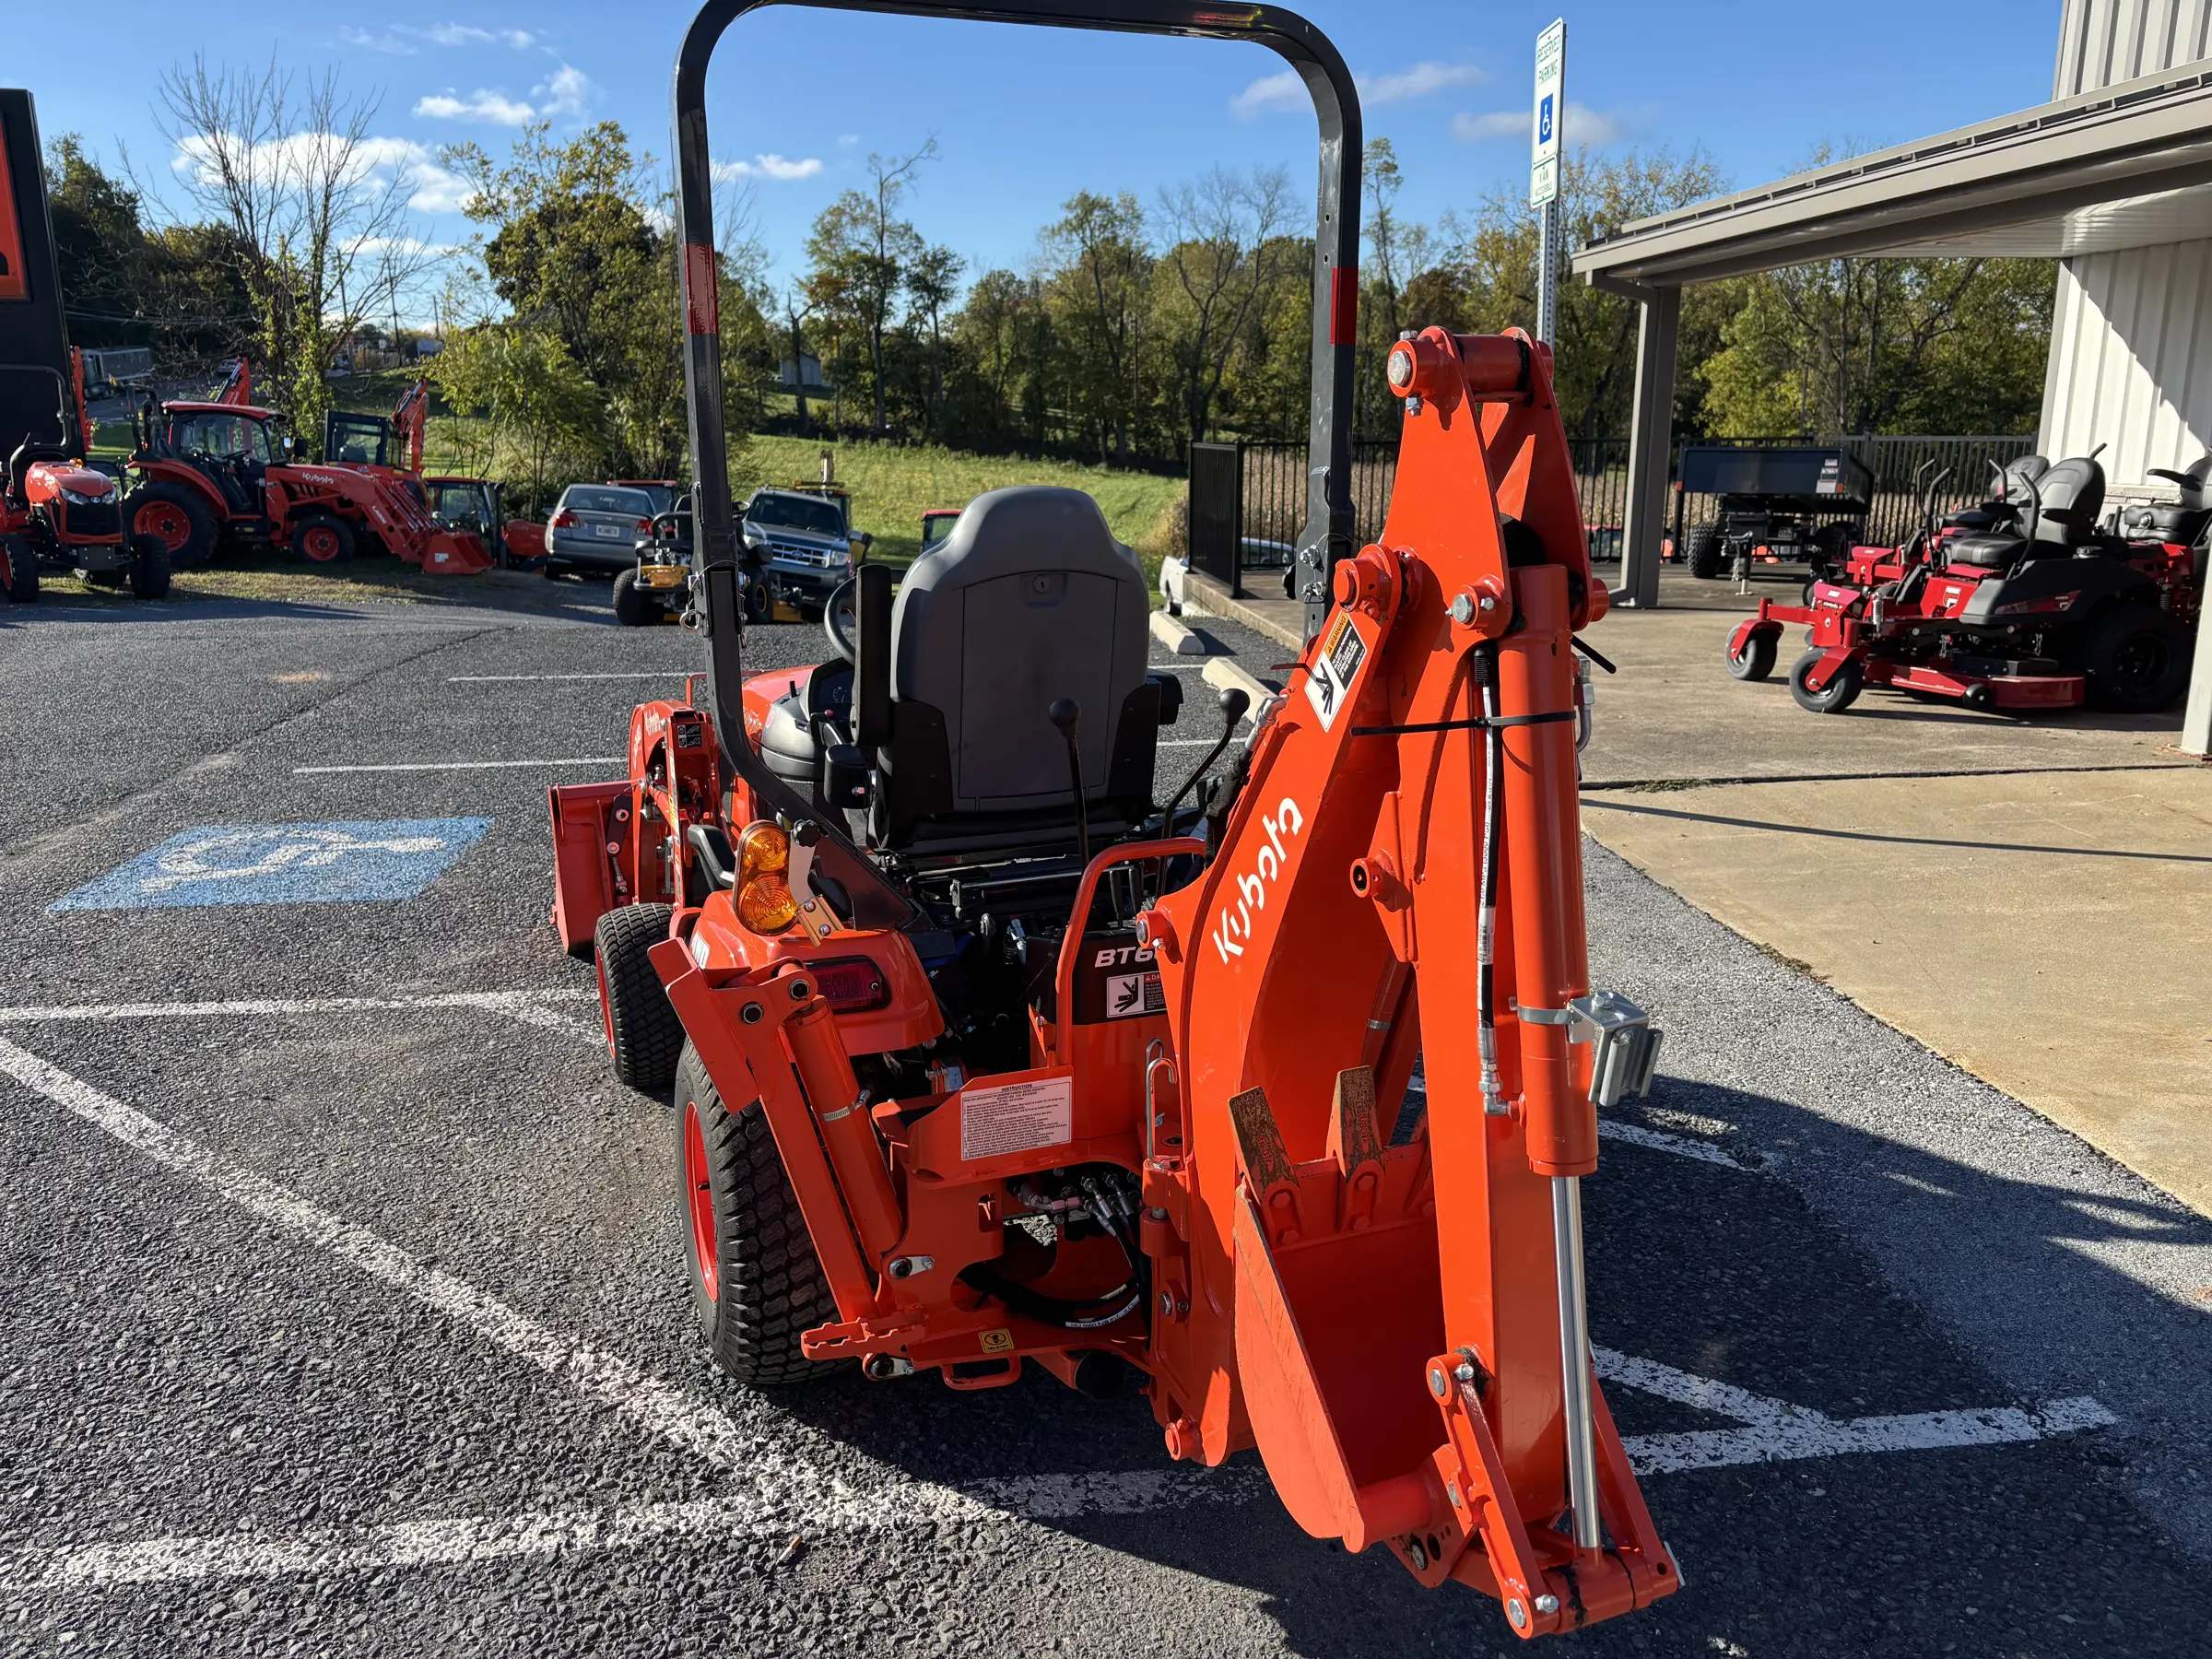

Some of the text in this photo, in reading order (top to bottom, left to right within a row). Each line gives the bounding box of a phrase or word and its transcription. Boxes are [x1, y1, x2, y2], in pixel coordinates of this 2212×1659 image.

[1536, 34, 1560, 65] RESERVED
[1538, 58, 1558, 85] PARKING
[1539, 169, 1549, 183] VAN
[302, 471, 335, 485] Kubota
[1329, 615, 1347, 646] WARNING
[1212, 797, 1304, 965] Kubota
[1094, 946, 1157, 968] BT6
[1001, 1084, 1032, 1092] INSTRUCTION
